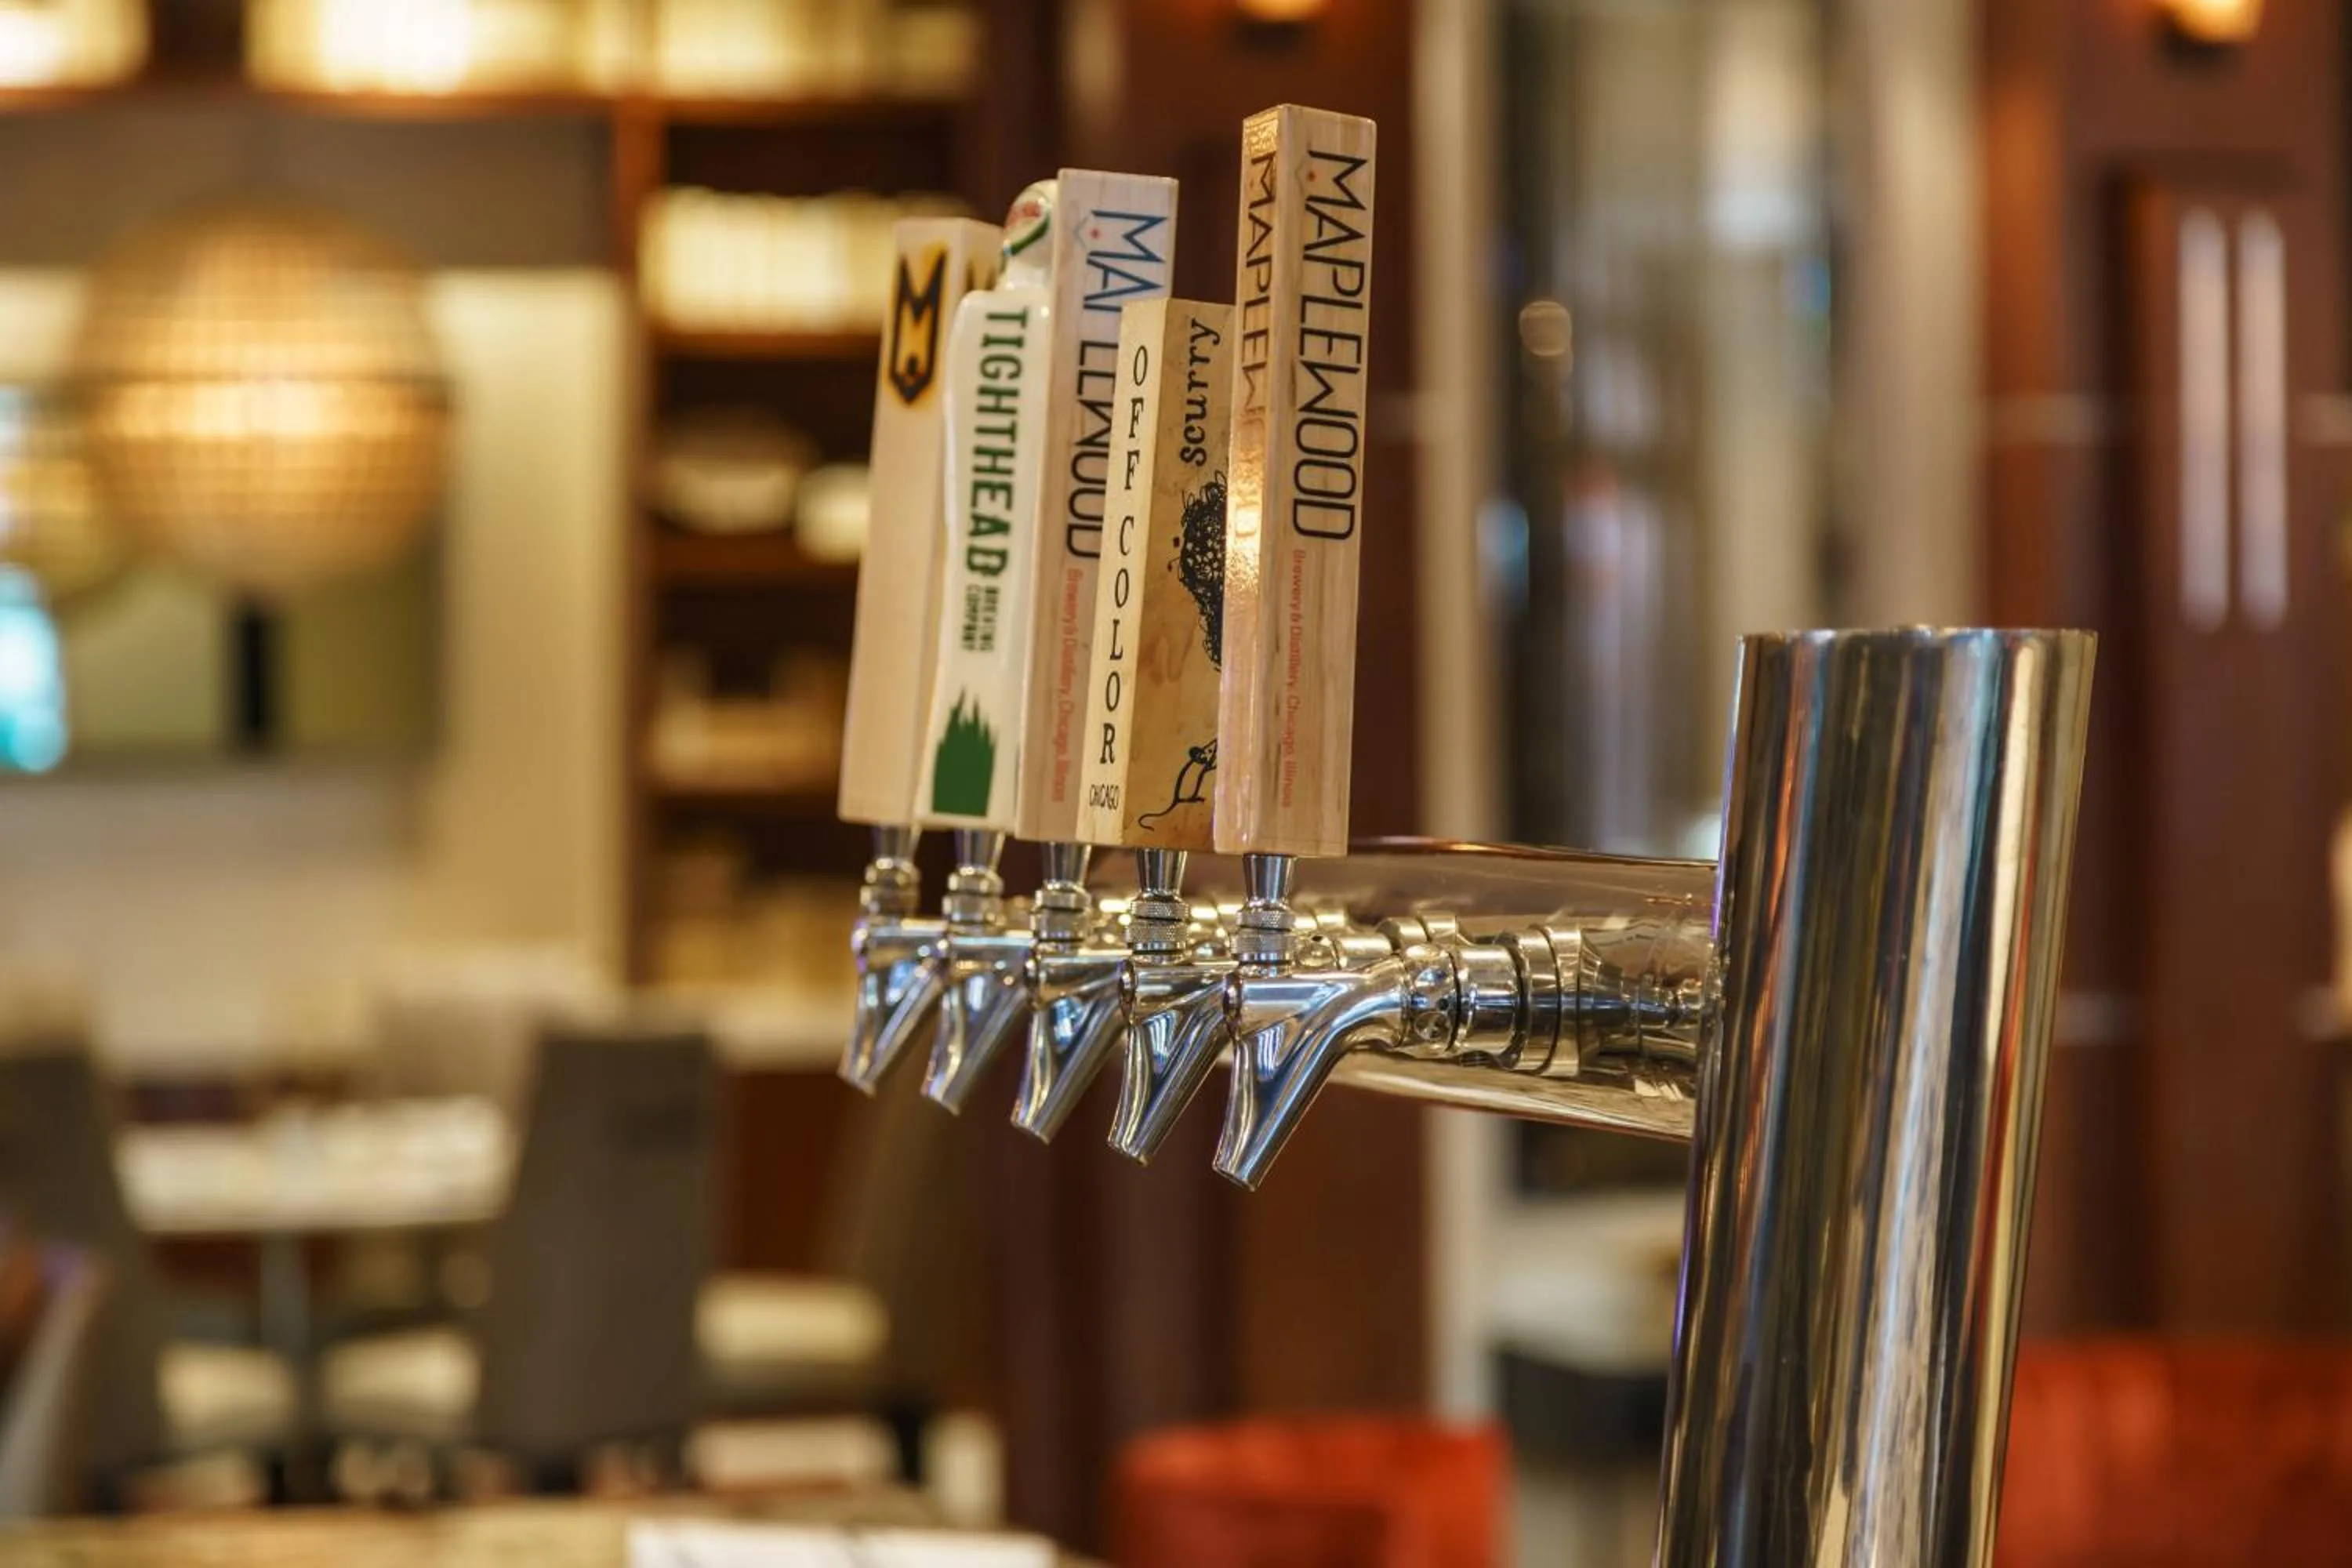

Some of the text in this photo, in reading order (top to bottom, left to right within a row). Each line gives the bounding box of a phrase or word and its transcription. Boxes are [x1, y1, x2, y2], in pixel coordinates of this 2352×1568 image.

[967, 307, 1029, 576] TIGHTHEAD
[1067, 209, 1168, 560] MALEWOOD
[1236, 151, 1278, 542] MAPLEW
[1294, 150, 1370, 541] MAPLEWOOD
[1099, 344, 1149, 765] OFF COLOR
[1288, 549, 1307, 611] Brewery
